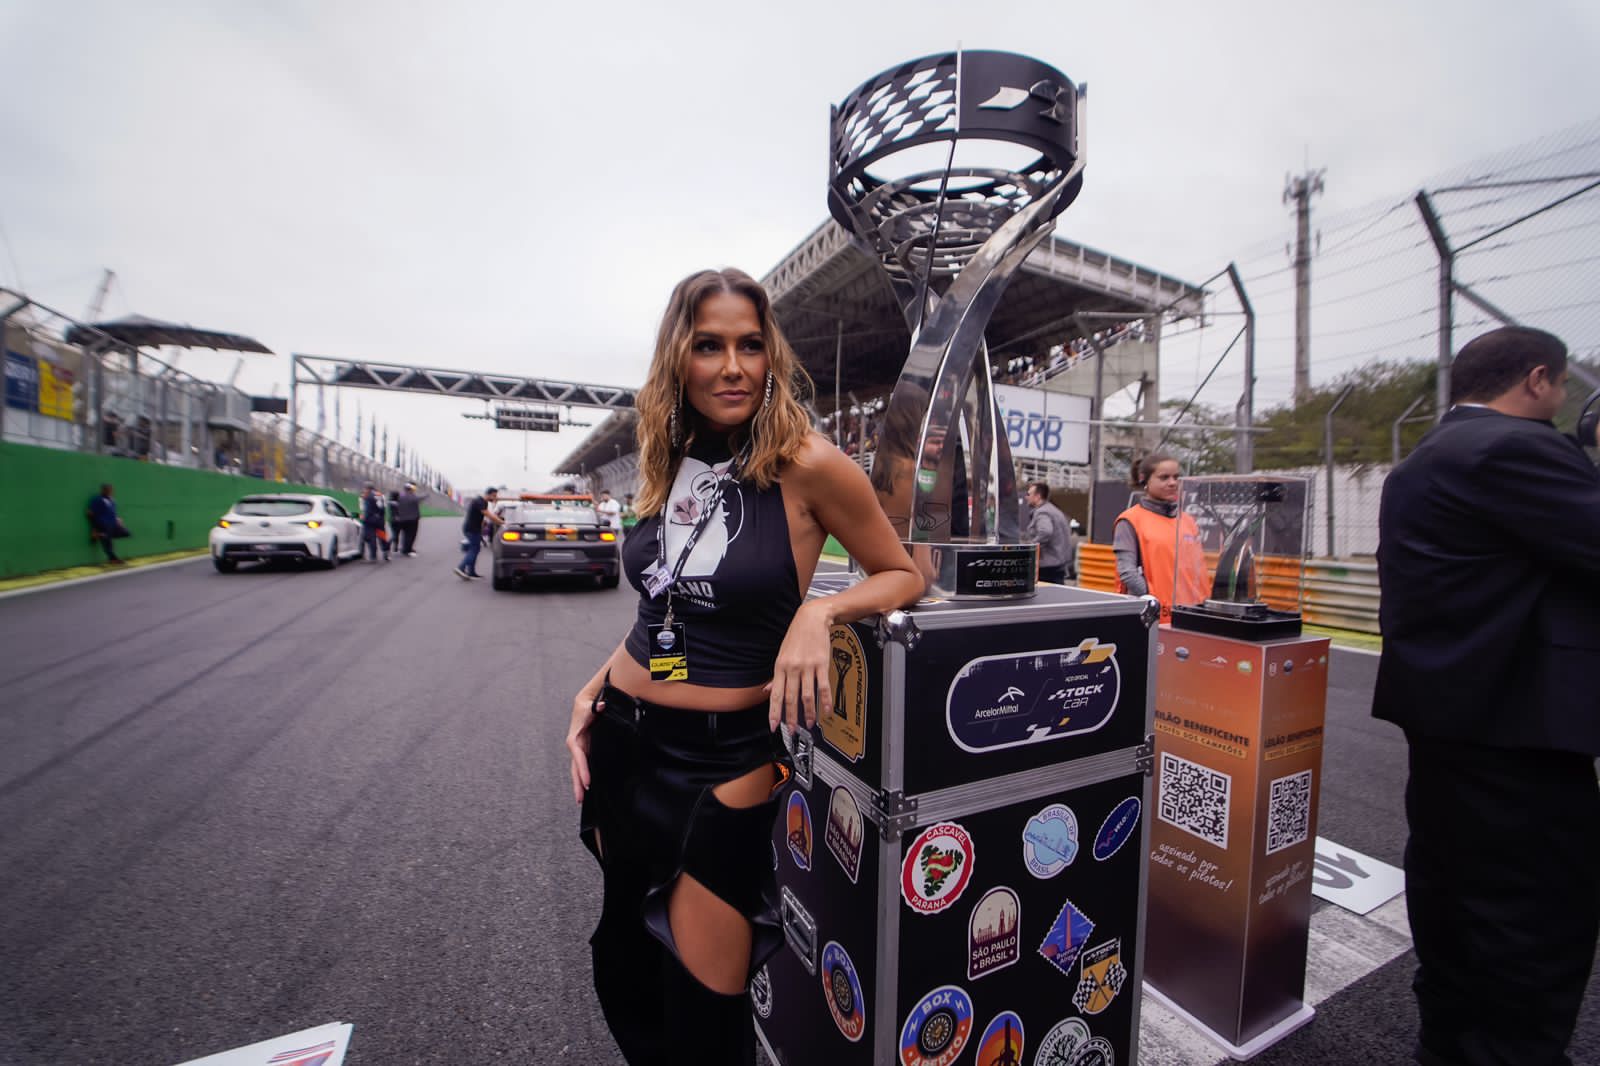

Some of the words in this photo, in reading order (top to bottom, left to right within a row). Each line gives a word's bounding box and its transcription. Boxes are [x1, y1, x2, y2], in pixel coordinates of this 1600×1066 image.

[1006, 408, 1064, 452] BRB
[1048, 684, 1104, 701] STOCK
[975, 703, 1019, 719] ArcelorMittal
[1155, 709, 1182, 725] EILÃO
[1184, 718, 1251, 748] BENEFICENTE
[926, 826, 967, 846] CASCAVEL
[1030, 858, 1049, 873] BRASIL
[1150, 851, 1173, 868] todos
[1177, 864, 1189, 874] os
[1199, 859, 1219, 880] por
[972, 945, 989, 960] SÃO
[991, 936, 1016, 953] PAULO
[834, 948, 852, 974] BOX
[979, 952, 1008, 969] BRASIL
[921, 991, 952, 1015] BOX
